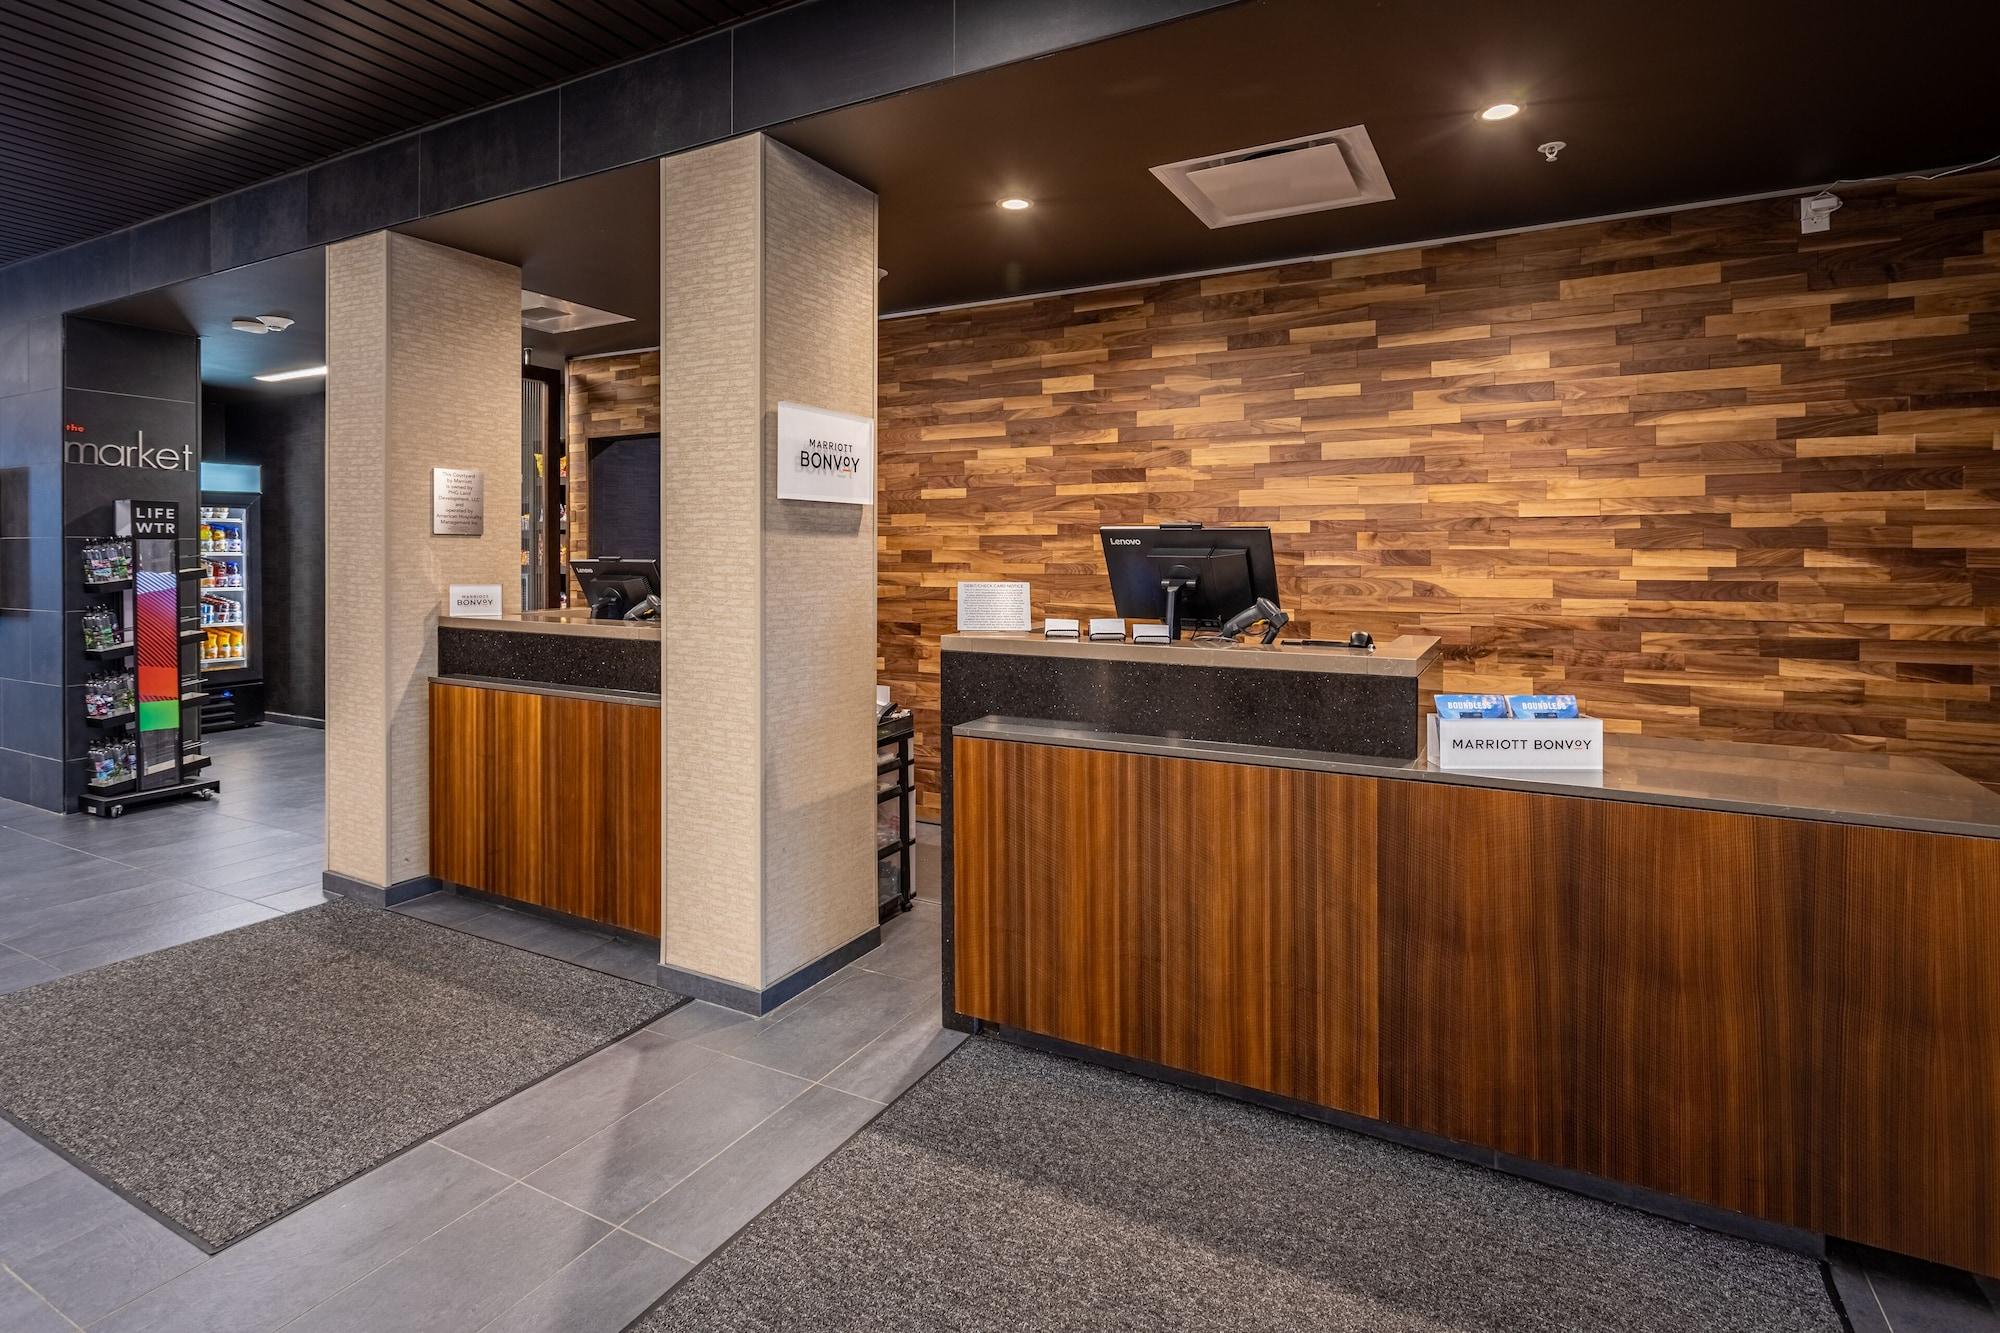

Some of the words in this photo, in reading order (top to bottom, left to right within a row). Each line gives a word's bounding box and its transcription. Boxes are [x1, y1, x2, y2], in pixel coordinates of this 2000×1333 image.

[66, 424, 85, 433] the
[64, 430, 193, 471] market
[809, 438, 853, 453] MARRIOTT
[800, 450, 860, 473] BONVOY
[136, 507, 175, 520] LIFE
[135, 522, 175, 534] WTR
[1110, 537, 1141, 546] Lenovo
[1447, 701, 1493, 710] BOUNDLESS
[1521, 702, 1567, 711] BOUNDLESS
[1452, 739, 1528, 750] MARRIOTT
[1534, 739, 1592, 750] BONVOY
